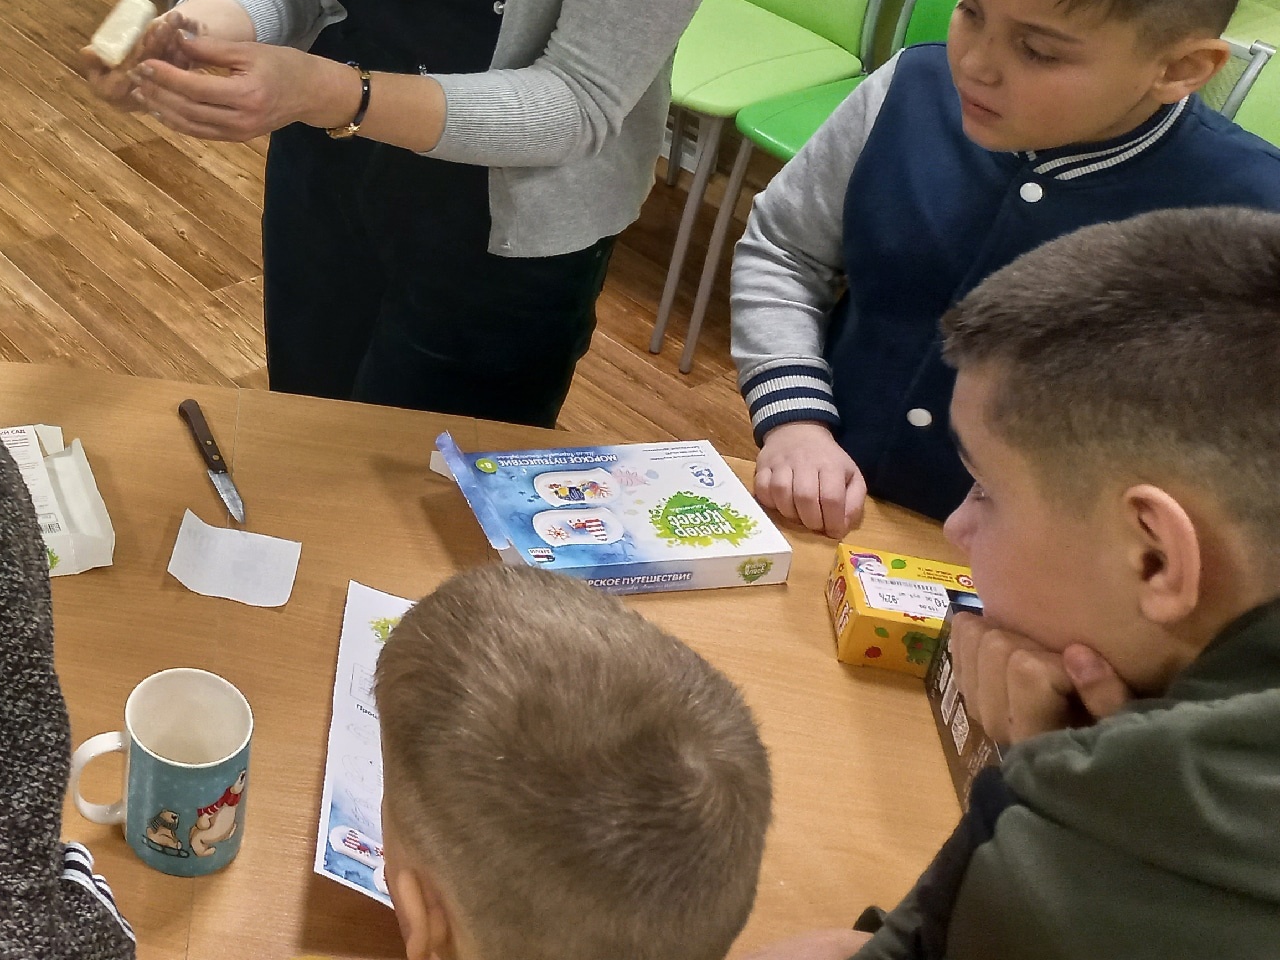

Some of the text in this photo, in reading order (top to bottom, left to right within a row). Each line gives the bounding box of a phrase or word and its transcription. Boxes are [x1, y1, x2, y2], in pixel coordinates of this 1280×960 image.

[498, 456, 568, 467] ПУТЕШЕСТВИЕ
[568, 453, 617, 464] МОРСКОЕ
[587, 578, 621, 587] РСКОЕ
[622, 571, 693, 585] ПУТЕШЕСТВИЕ
